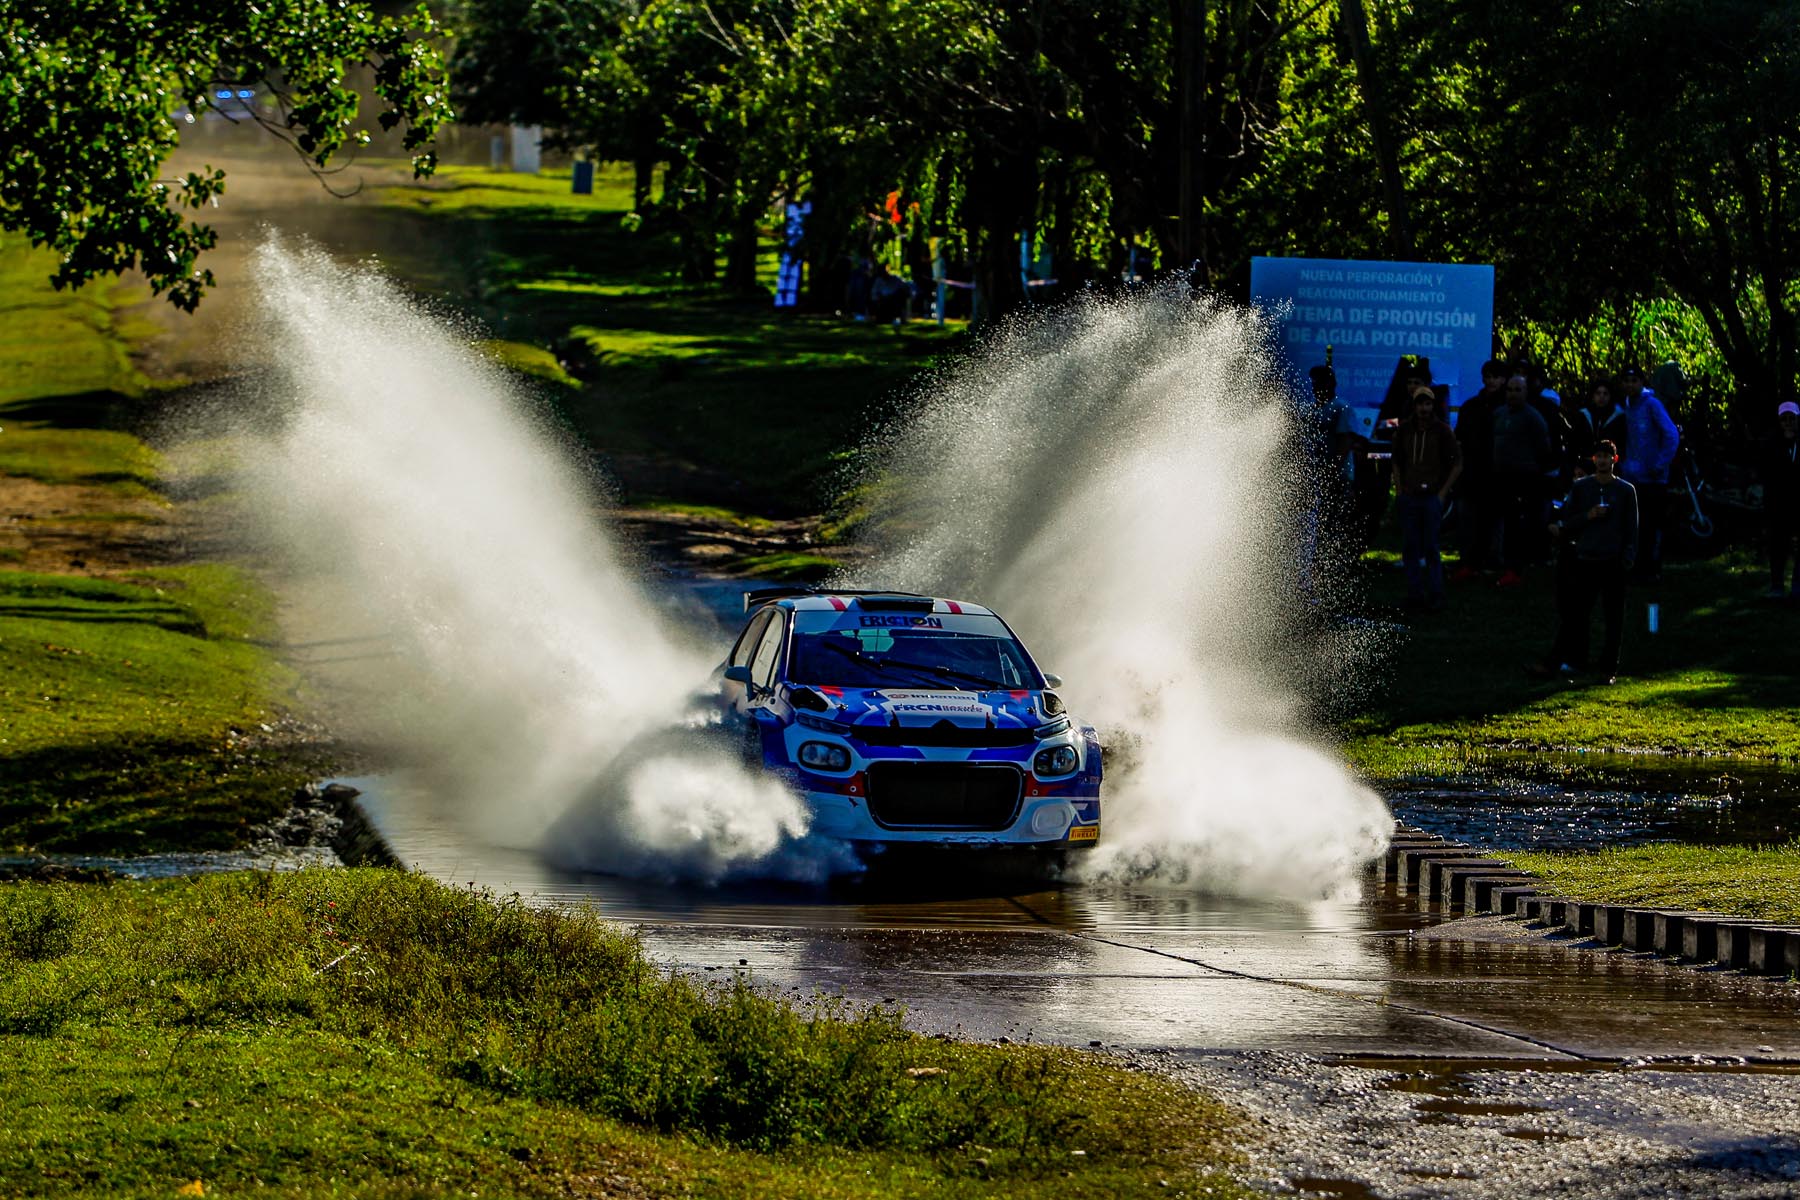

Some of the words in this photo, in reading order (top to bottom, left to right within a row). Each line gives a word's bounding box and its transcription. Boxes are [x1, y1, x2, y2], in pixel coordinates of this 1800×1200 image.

[1300, 269, 1344, 282] NUEVA
[1347, 271, 1432, 285] PERFORACIÓN
[1436, 273, 1444, 285] Y
[1298, 287, 1445, 303] REACONDICIONAMIENTO
[1349, 308, 1375, 324] DE
[1377, 308, 1476, 328] PROVISIÓN
[1287, 327, 1311, 344] DE
[1315, 329, 1367, 345] AGUA
[1371, 331, 1454, 348] POTABLE
